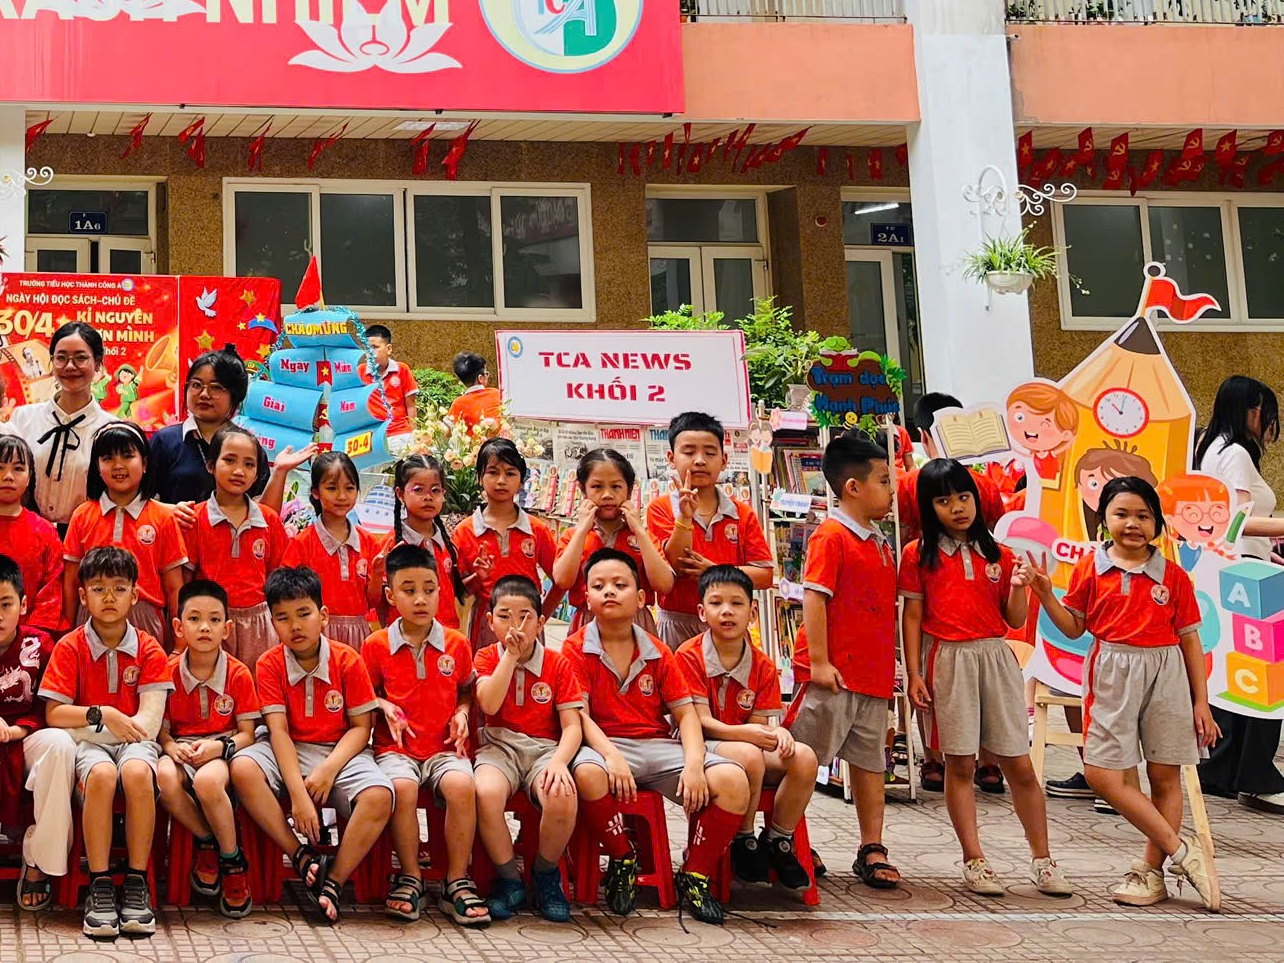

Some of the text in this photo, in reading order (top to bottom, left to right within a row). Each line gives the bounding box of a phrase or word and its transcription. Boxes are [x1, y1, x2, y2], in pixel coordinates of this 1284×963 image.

[76, 280, 97, 288] THÀNH
[98, 280, 116, 288] CÔNG
[6, 293, 31, 303] NGÀY
[33, 293, 49, 305] HỘI
[51, 295, 71, 305] ĐỌC
[124, 293, 136, 306] ĐỀ
[95, 308, 153, 325] NGUYÊN
[116, 325, 155, 342] MÌNH
[103, 346, 127, 356] hối 2
[538, 352, 691, 371] TCA NEWS
[566, 376, 665, 402] KHỐI 2
[347, 437, 370, 454] 30-4
[1227, 582, 1251, 607] A
[1243, 623, 1264, 651] B
[1234, 668, 1259, 694] C
